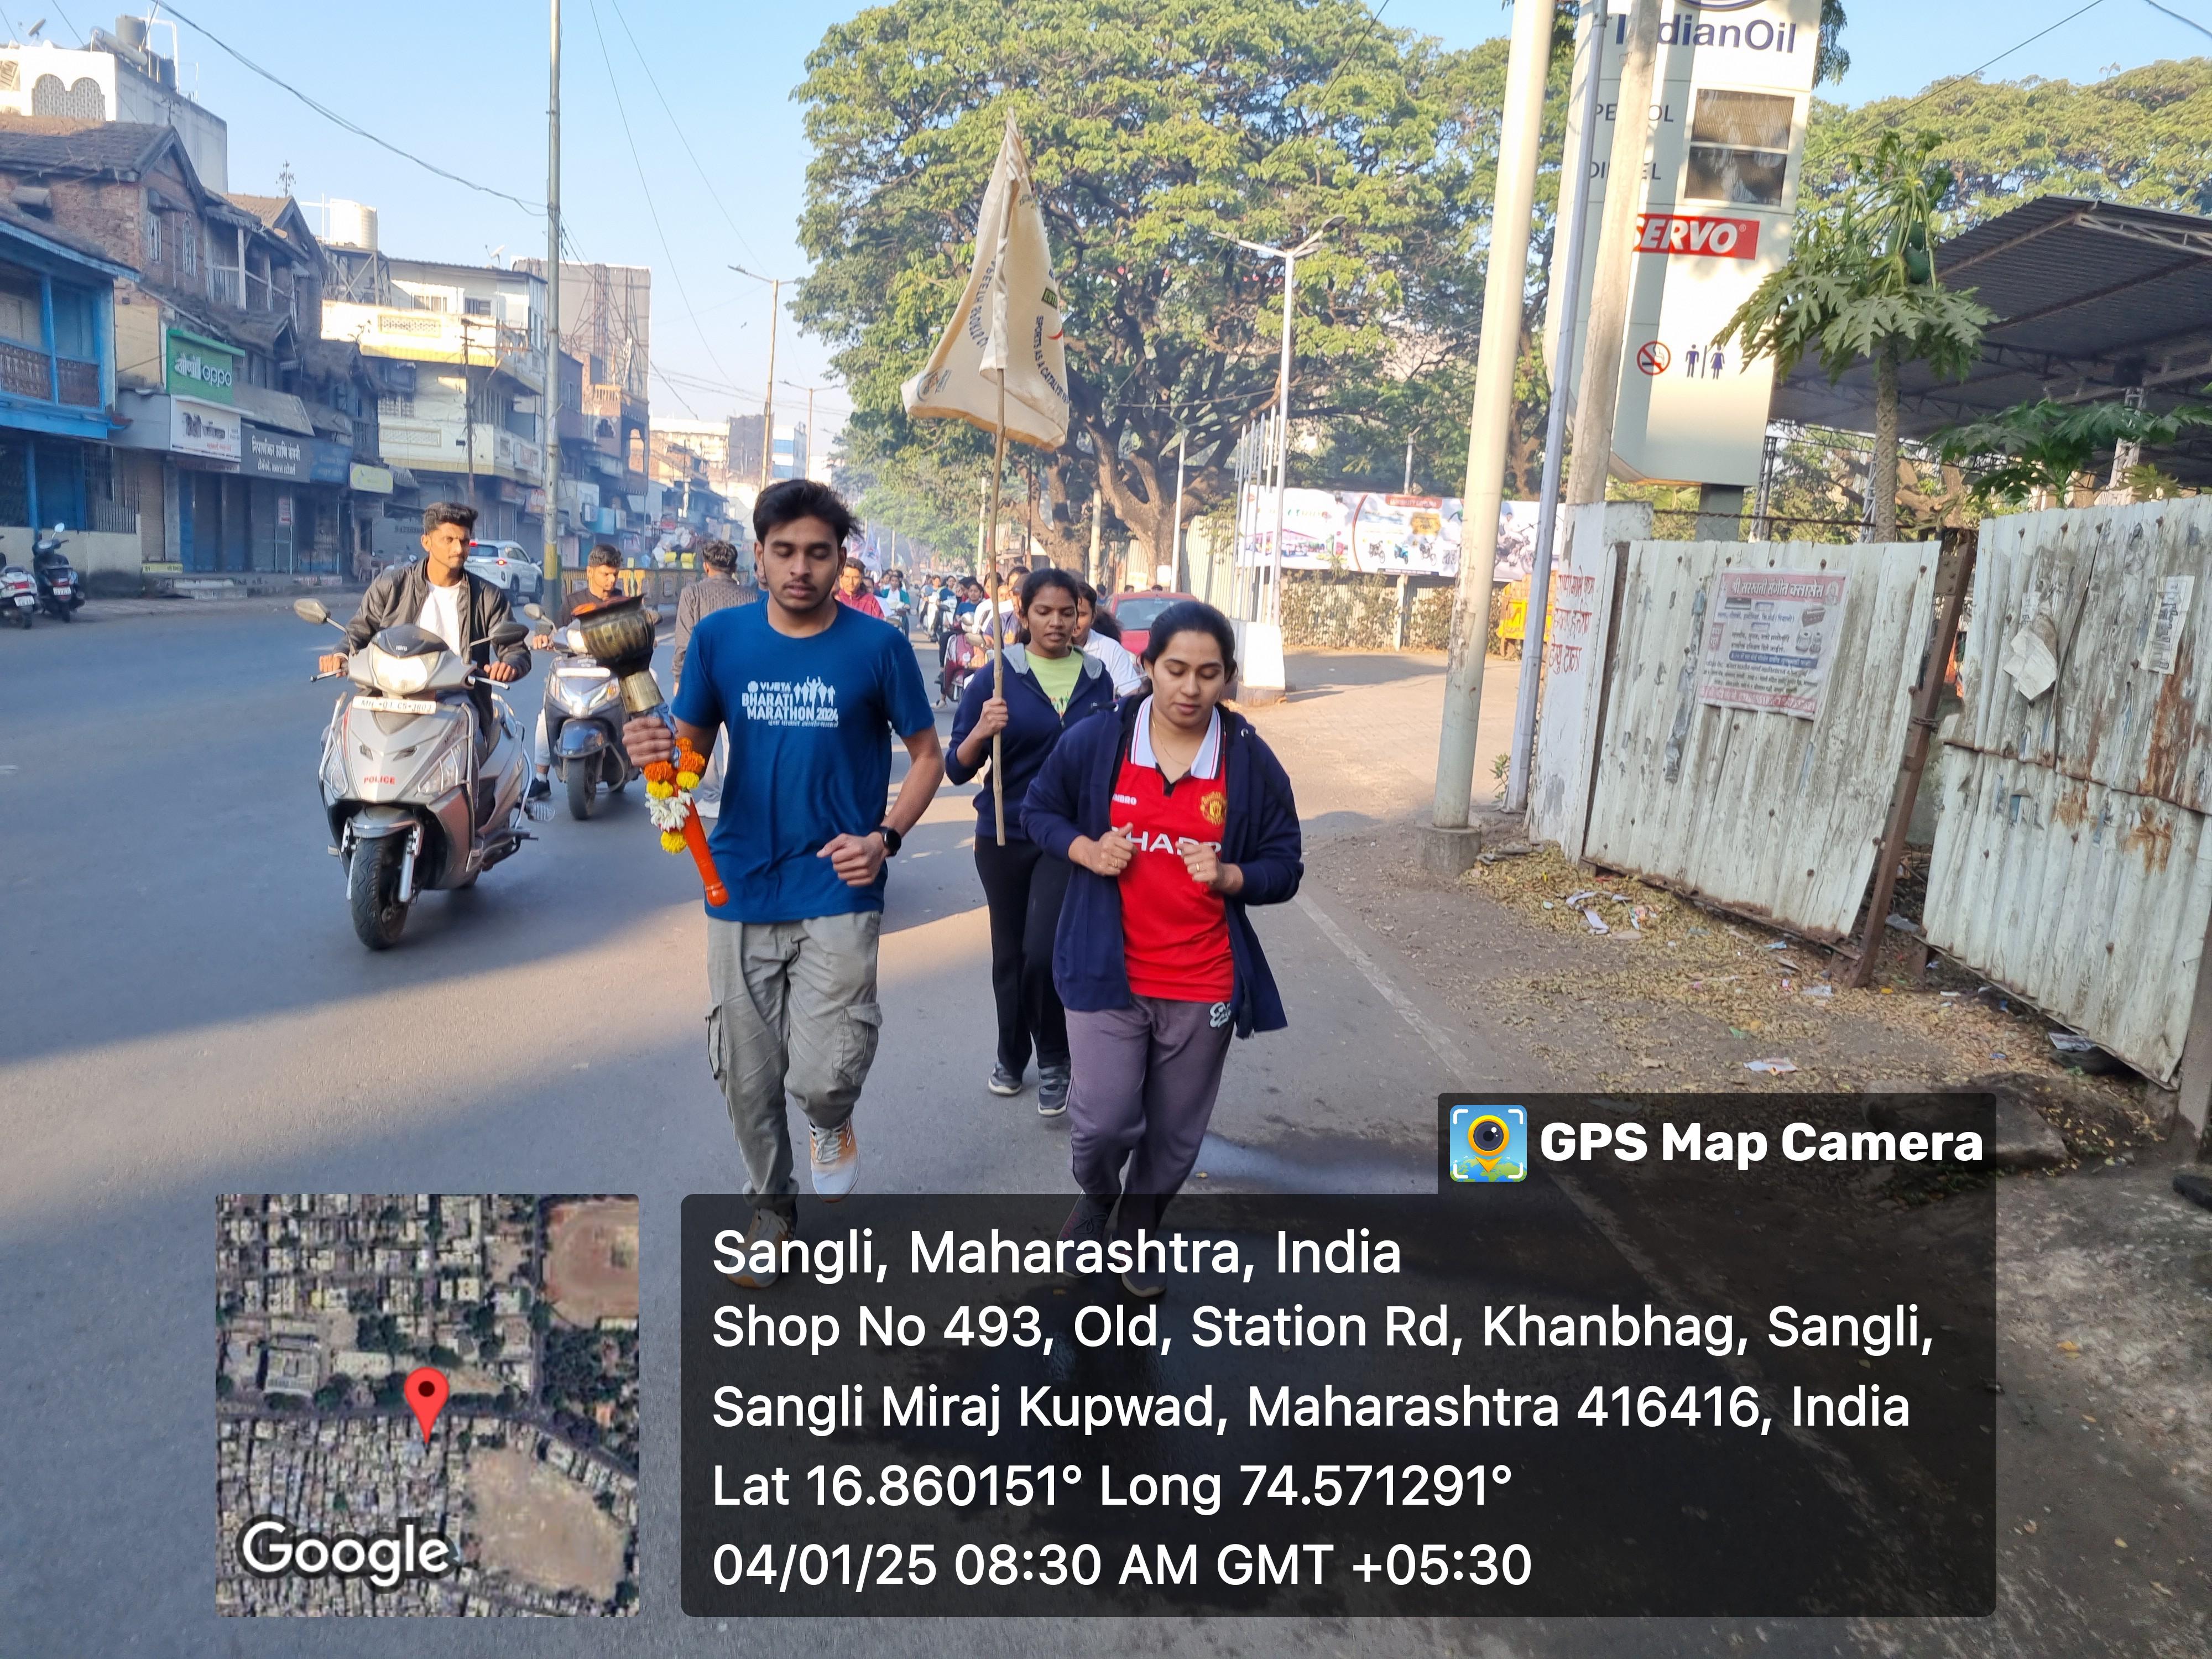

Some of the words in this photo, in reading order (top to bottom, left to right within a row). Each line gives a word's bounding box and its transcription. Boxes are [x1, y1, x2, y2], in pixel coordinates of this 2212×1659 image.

[1616, 14, 1797, 54] IdianOil
[1596, 103, 1674, 123] PEOL
[1590, 161, 1661, 180] DIL
[202, 364, 232, 388] oppo
[742, 692, 794, 707] BHARATI
[747, 706, 815, 721] MARATHON
[816, 707, 839, 721] 2024
[363, 776, 396, 786] POLICE
[1111, 826, 1222, 856] HAP
